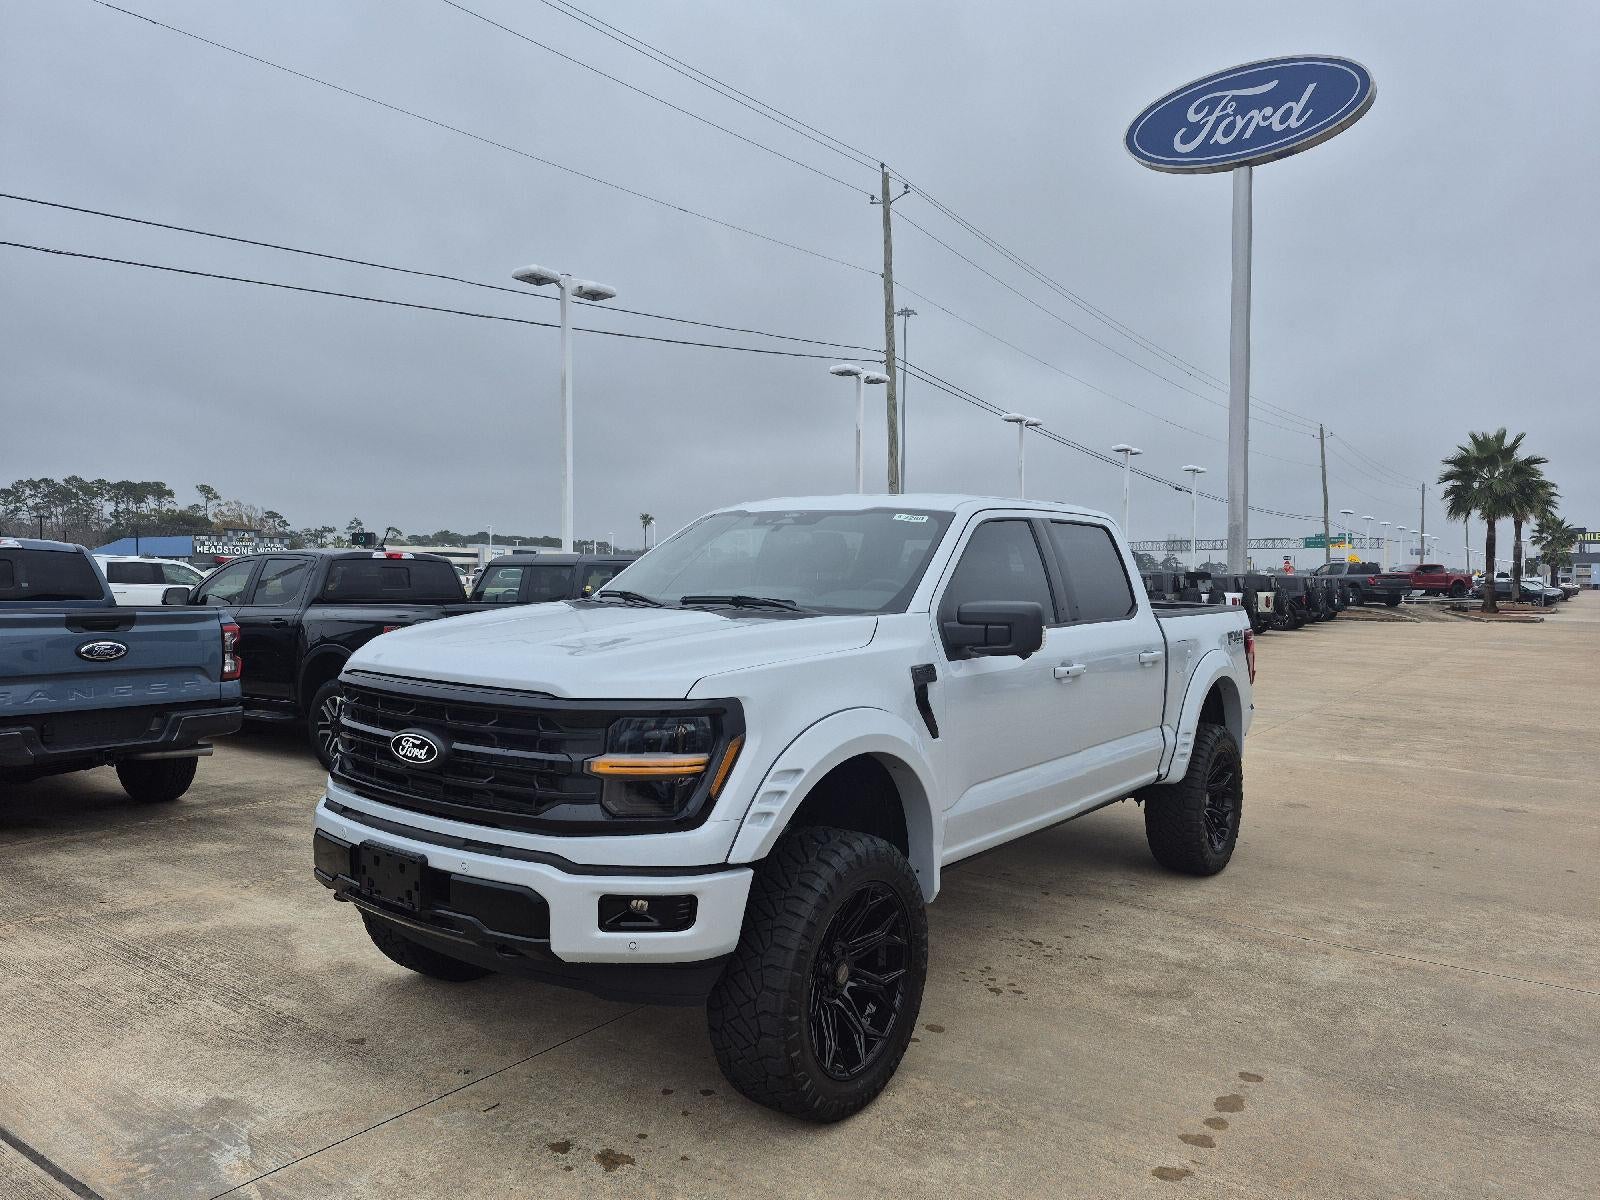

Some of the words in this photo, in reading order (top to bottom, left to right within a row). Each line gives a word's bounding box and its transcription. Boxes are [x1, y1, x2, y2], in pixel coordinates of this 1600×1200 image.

[1173, 79, 1318, 153] Ford
[196, 545, 253, 555] HEADSTONE
[92, 645, 117, 656] Ford
[398, 737, 429, 760] Ford
